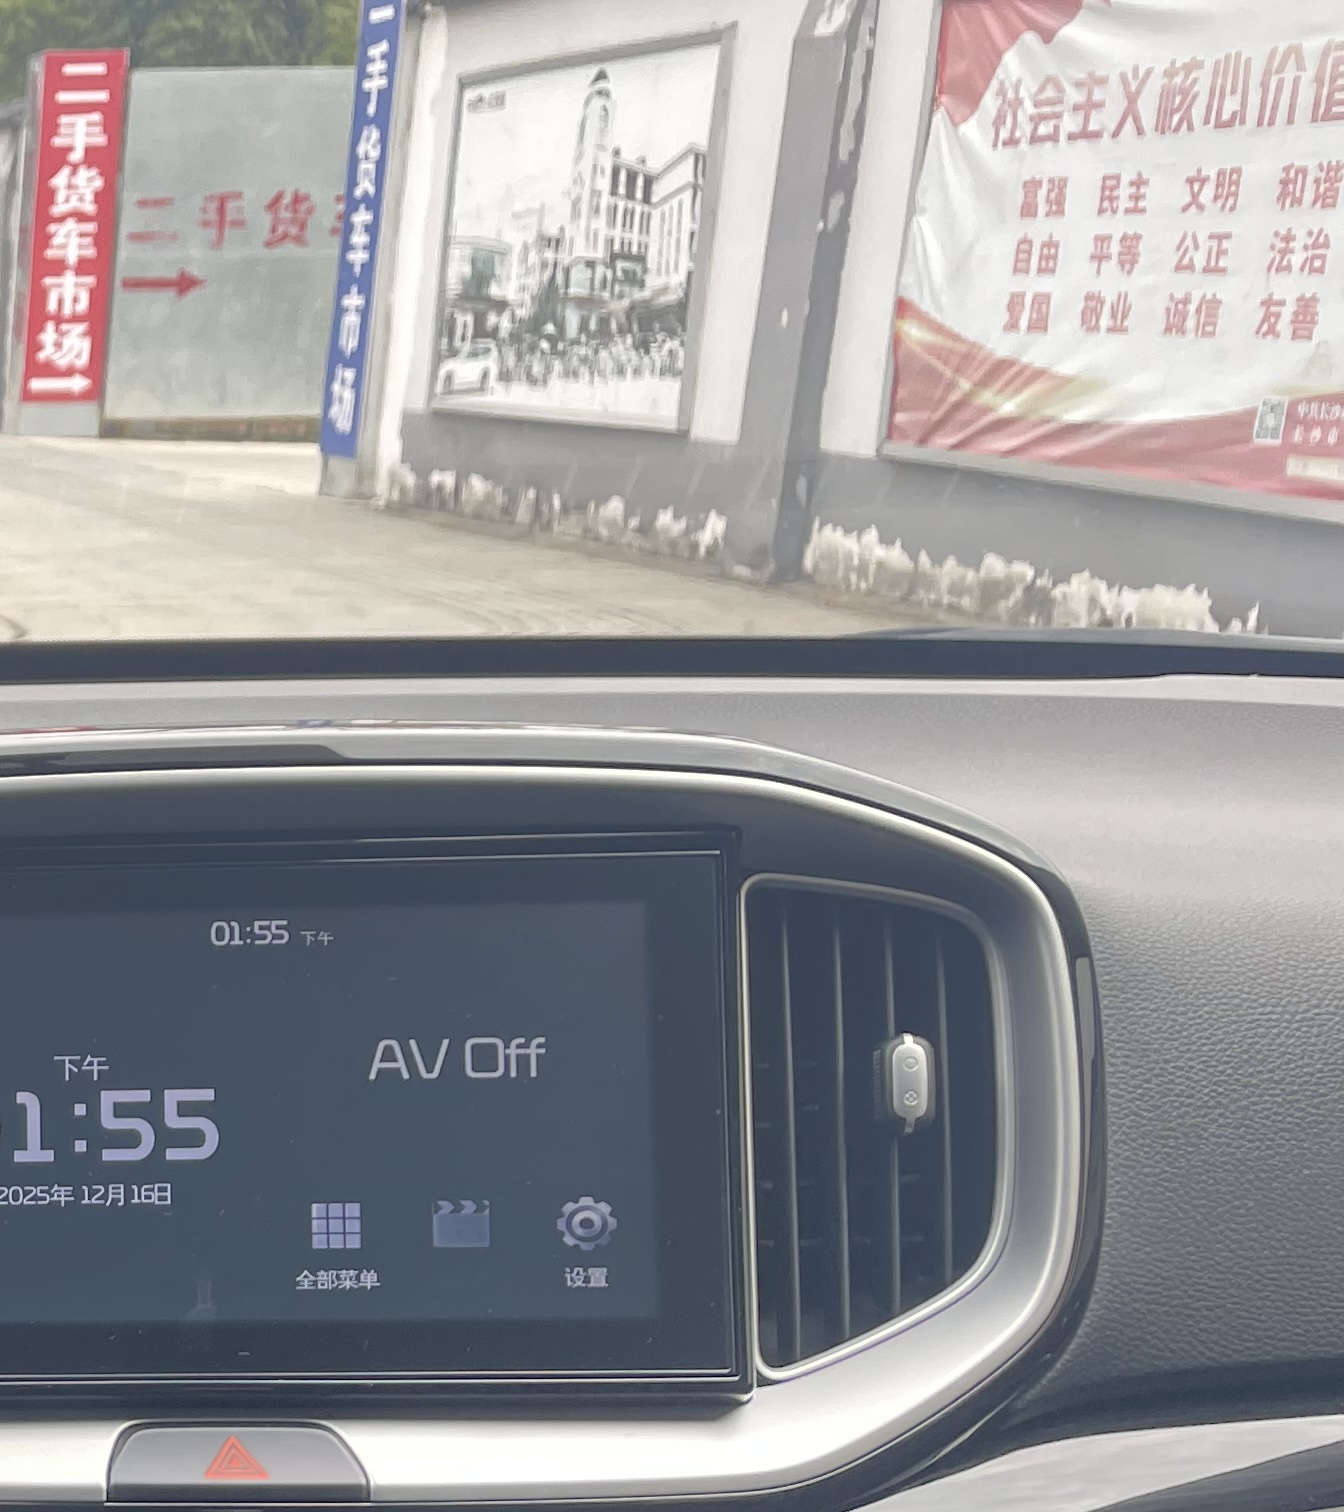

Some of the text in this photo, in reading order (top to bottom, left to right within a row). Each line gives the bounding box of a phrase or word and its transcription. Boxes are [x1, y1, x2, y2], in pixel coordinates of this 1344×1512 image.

[1019, 160, 1344, 219] 富强 民主 文明 和谐
[35, 62, 110, 370] 二手货车市场
[1012, 227, 1331, 277] 自由 平等 公正 法治
[1003, 289, 1320, 342] 爱国 敬业 诚信 友善
[210, 920, 334, 946] 01:55 下午
[53, 1054, 110, 1082] 下午
[368, 1036, 546, 1081] AV Off
[81, 1183, 125, 1207] 12月
[130, 1183, 172, 1205] 16日
[295, 1268, 382, 1290] 全部菜单
[564, 1267, 609, 1288] 设置
